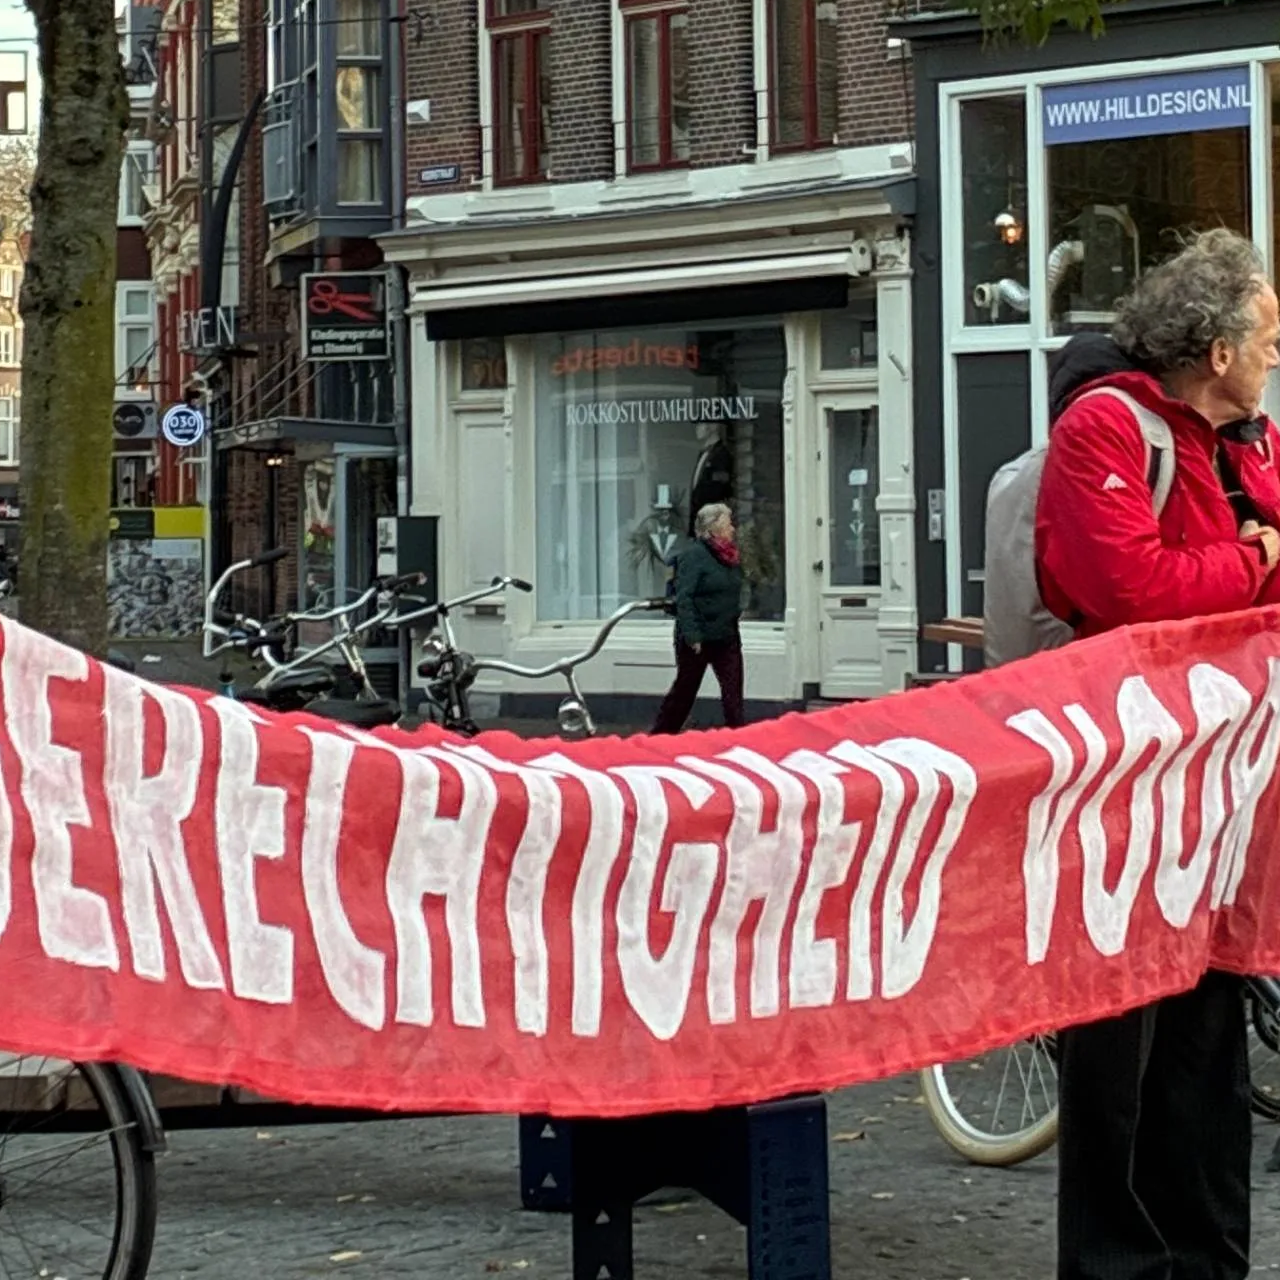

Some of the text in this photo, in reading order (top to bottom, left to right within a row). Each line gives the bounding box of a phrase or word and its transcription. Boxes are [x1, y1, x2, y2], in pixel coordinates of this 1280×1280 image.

[1047, 84, 1251, 127] WWW.HILLDESIGN.NL
[170, 416, 196, 428] 030
[566, 396, 759, 425] ROKKOSTUUMHUREN.NL
